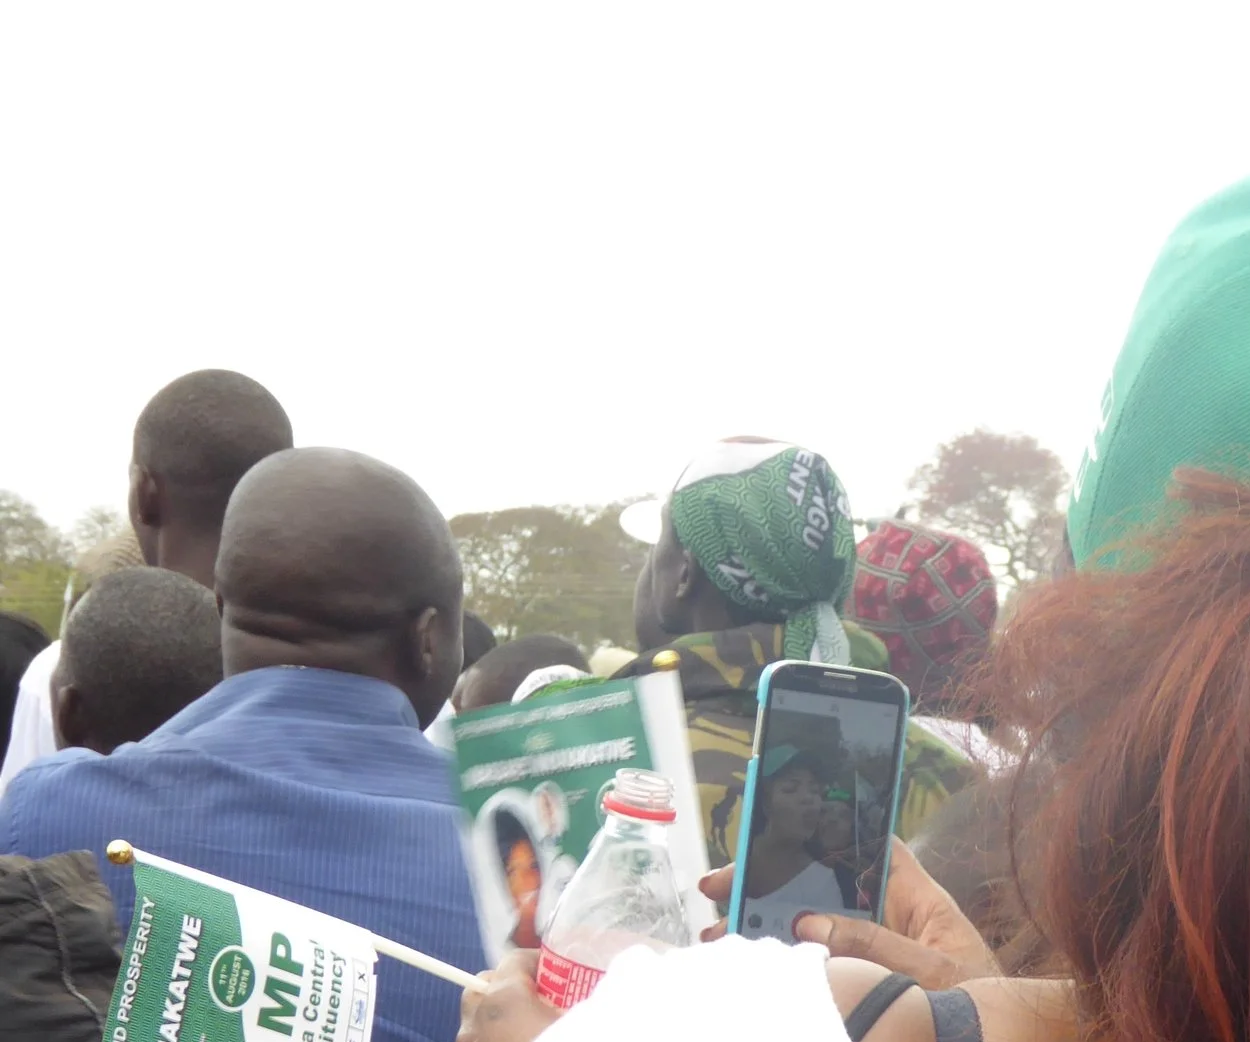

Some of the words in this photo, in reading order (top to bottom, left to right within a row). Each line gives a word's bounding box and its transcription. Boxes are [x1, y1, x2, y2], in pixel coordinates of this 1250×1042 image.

[117, 897, 155, 1022] PROSPERITY
[226, 953, 242, 1004] AUGUST
[257, 931, 304, 1037] MP
